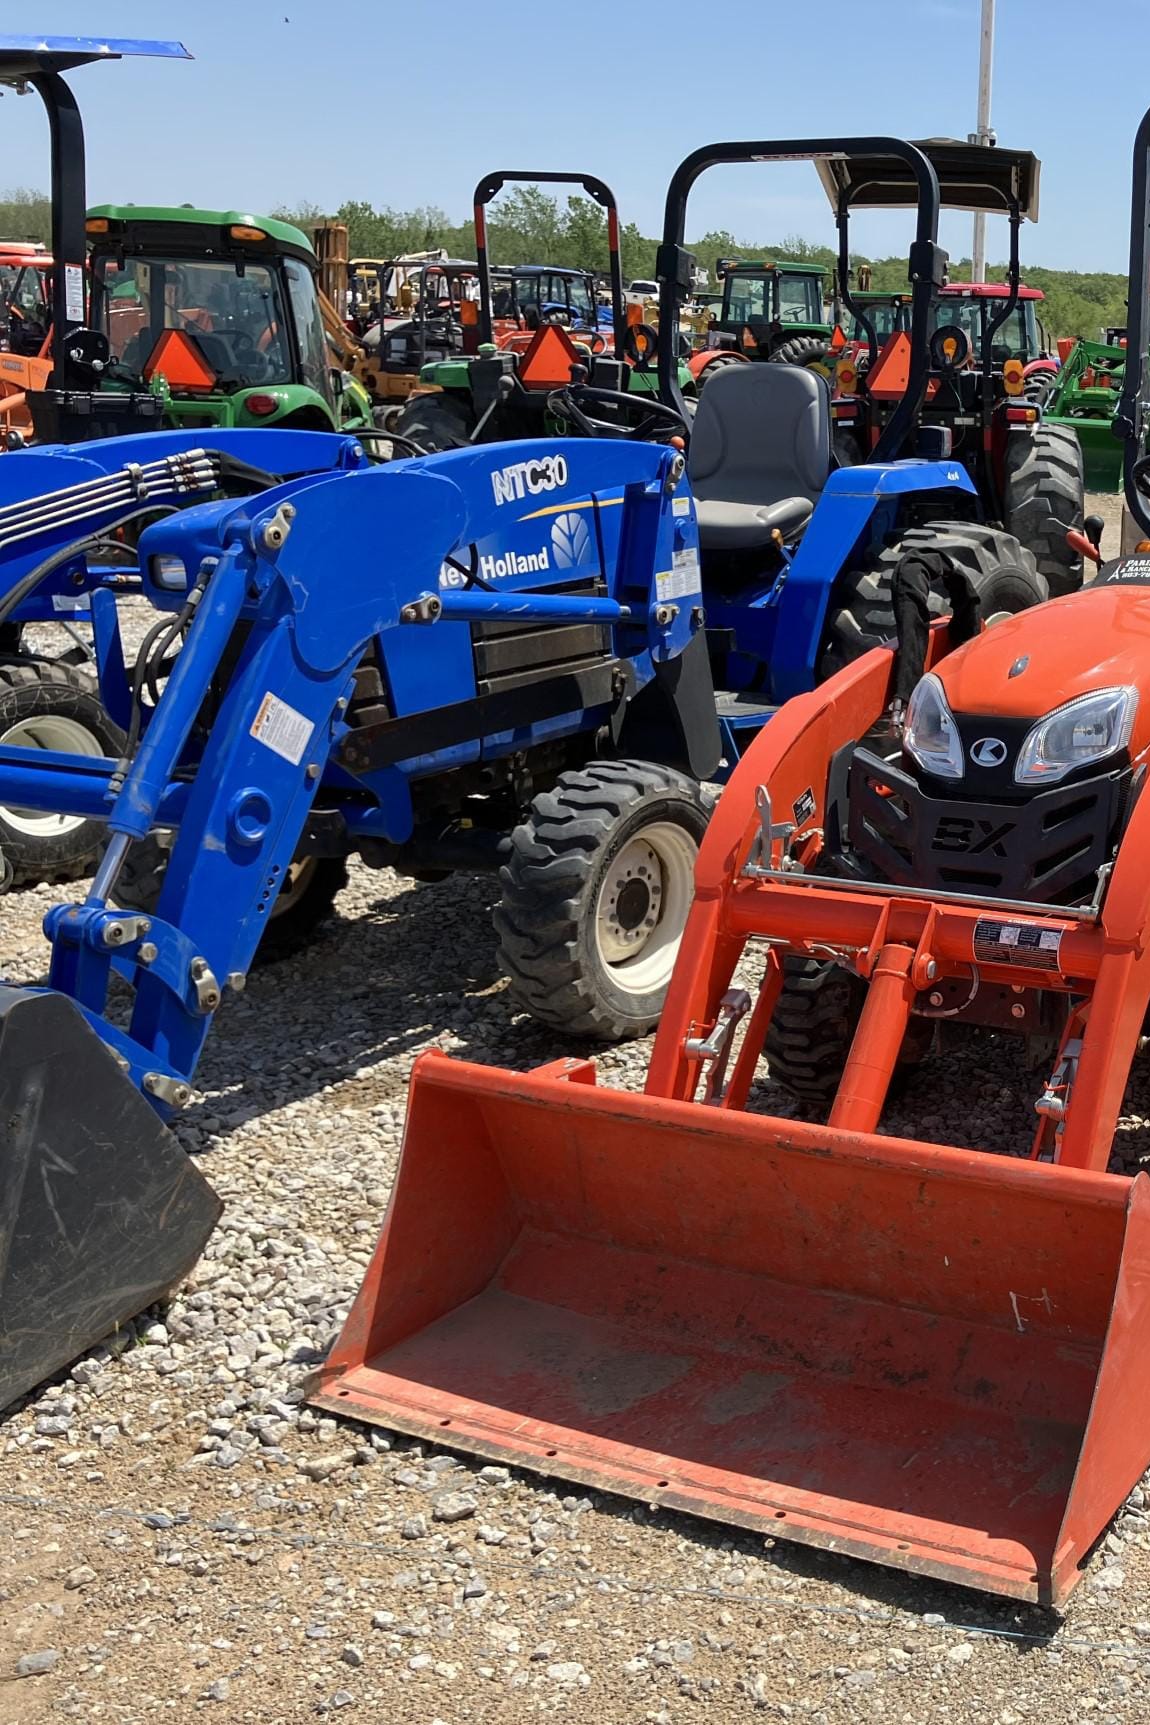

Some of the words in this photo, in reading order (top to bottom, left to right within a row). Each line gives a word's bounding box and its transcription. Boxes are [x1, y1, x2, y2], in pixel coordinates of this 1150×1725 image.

[490, 454, 567, 506] NTC30
[480, 546, 549, 579] Holland
[931, 816, 1017, 857] BX
